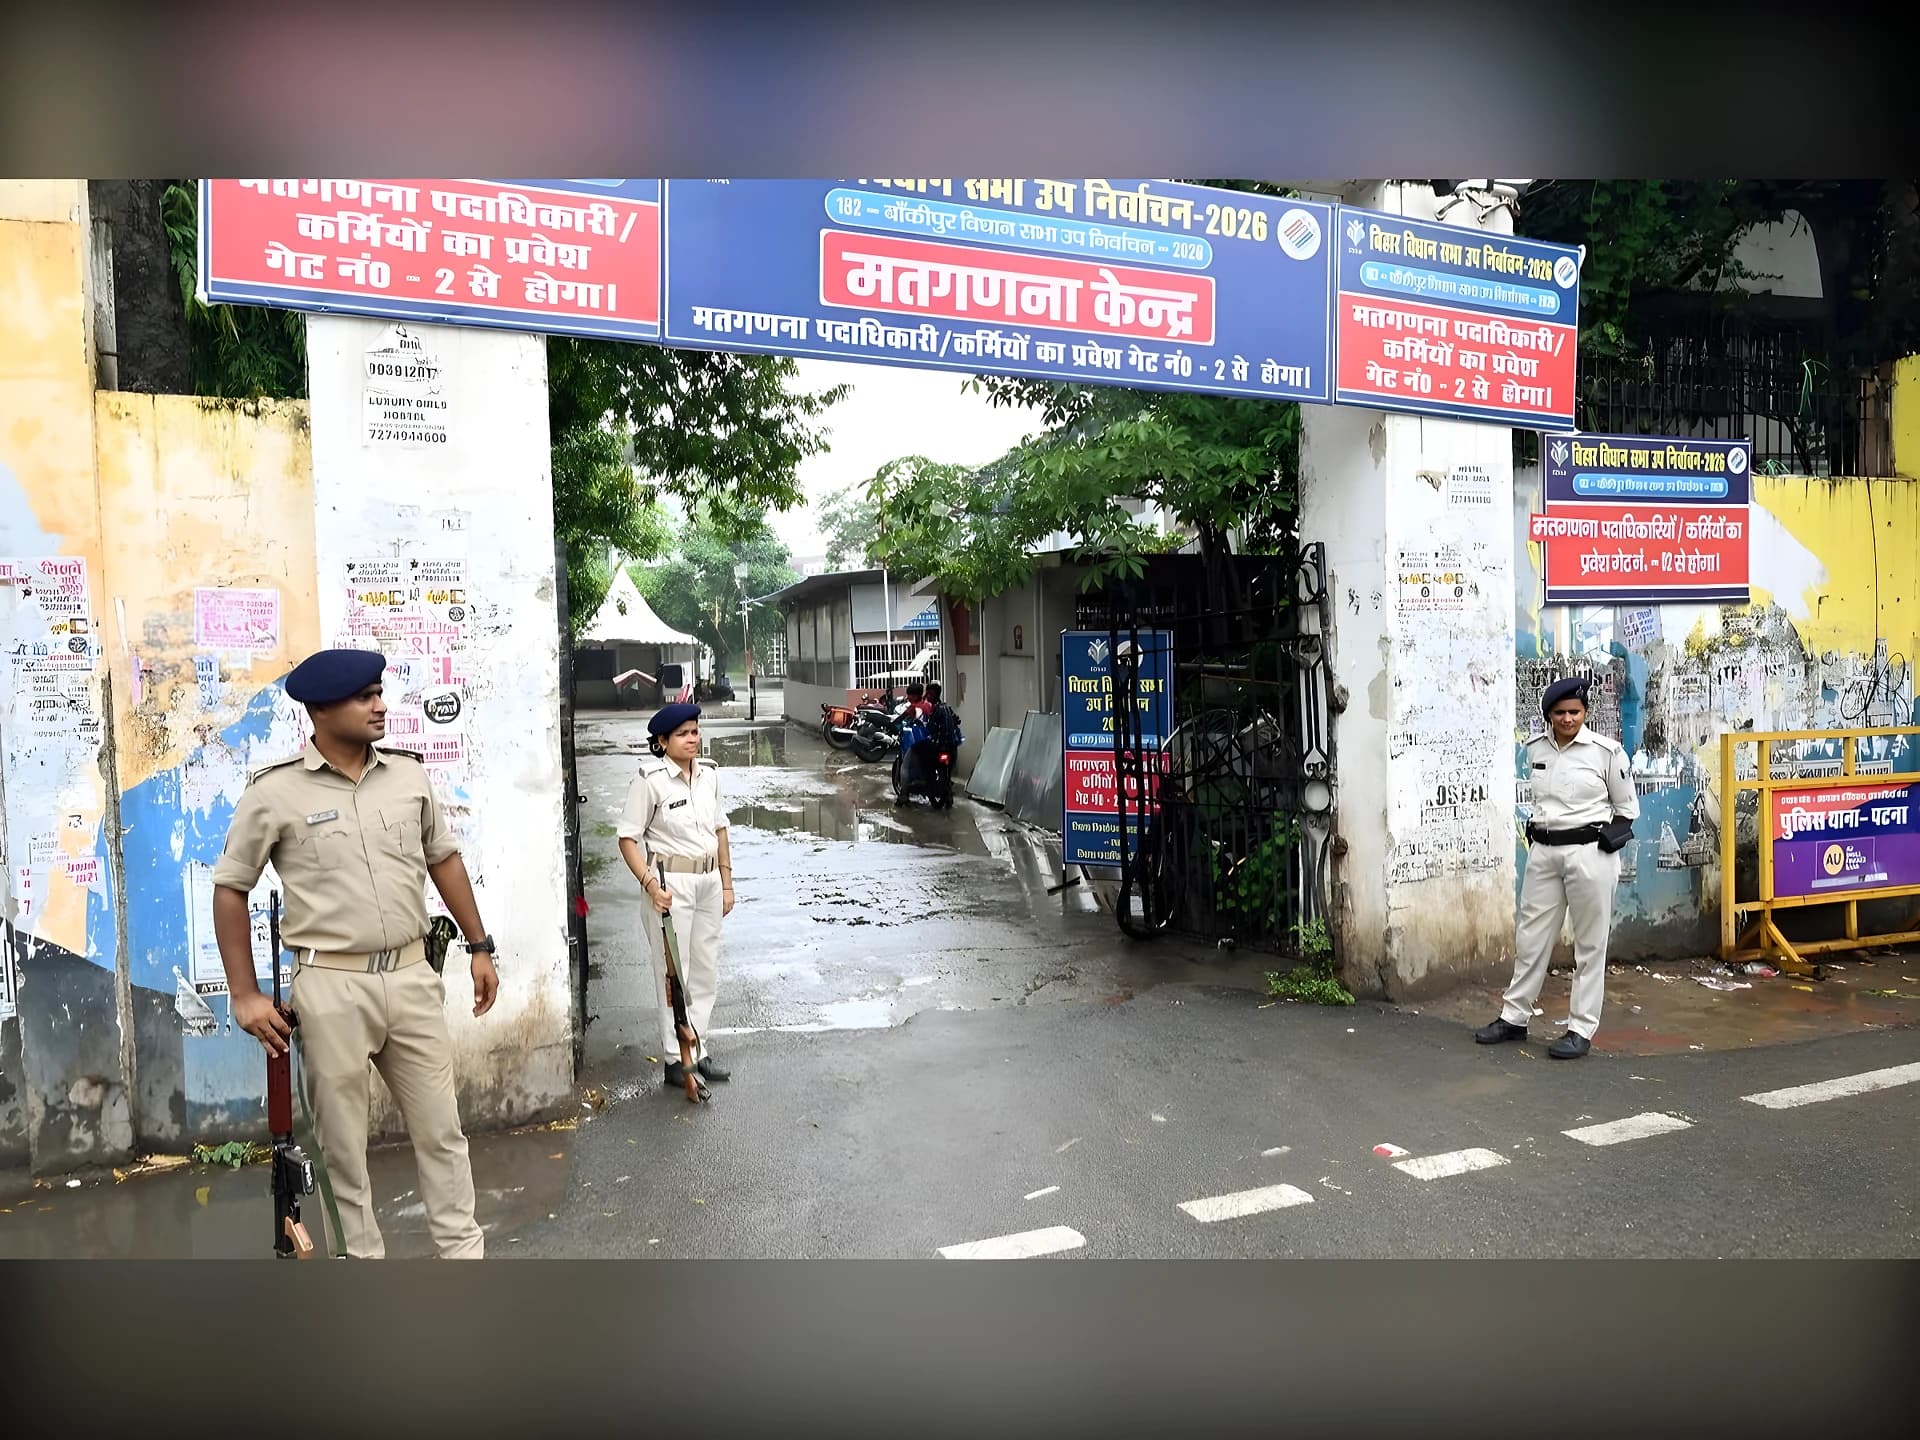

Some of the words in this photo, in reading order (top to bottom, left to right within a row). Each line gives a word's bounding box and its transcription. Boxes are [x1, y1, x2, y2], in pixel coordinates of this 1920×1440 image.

[1034, 179, 1077, 214] उप
[296, 211, 432, 252] कर्मियों
[441, 230, 494, 259] का
[504, 233, 592, 270] प्रवेश
[264, 241, 327, 280] गेट
[435, 268, 455, 296] 2
[467, 264, 502, 299] से
[841, 251, 1083, 323] मतगणना
[1090, 268, 1198, 337] केन्द्र
[1352, 305, 1448, 338] मतगणना
[692, 306, 809, 340] मतगणना
[1035, 341, 1065, 365] का
[1072, 340, 1121, 370] प्रवेश
[1128, 344, 1159, 373] गेट
[1214, 360, 1225, 381] 2
[1231, 355, 1249, 382] से
[1383, 338, 1454, 367] कर्मियों
[1459, 349, 1487, 372] का
[1366, 361, 1398, 389] गेट
[1454, 377, 1465, 399] 2
[1472, 375, 1490, 400] से
[1780, 807, 1826, 840] पुलिस
[1871, 806, 1909, 826] पटना
[1826, 852, 1842, 866] AU
